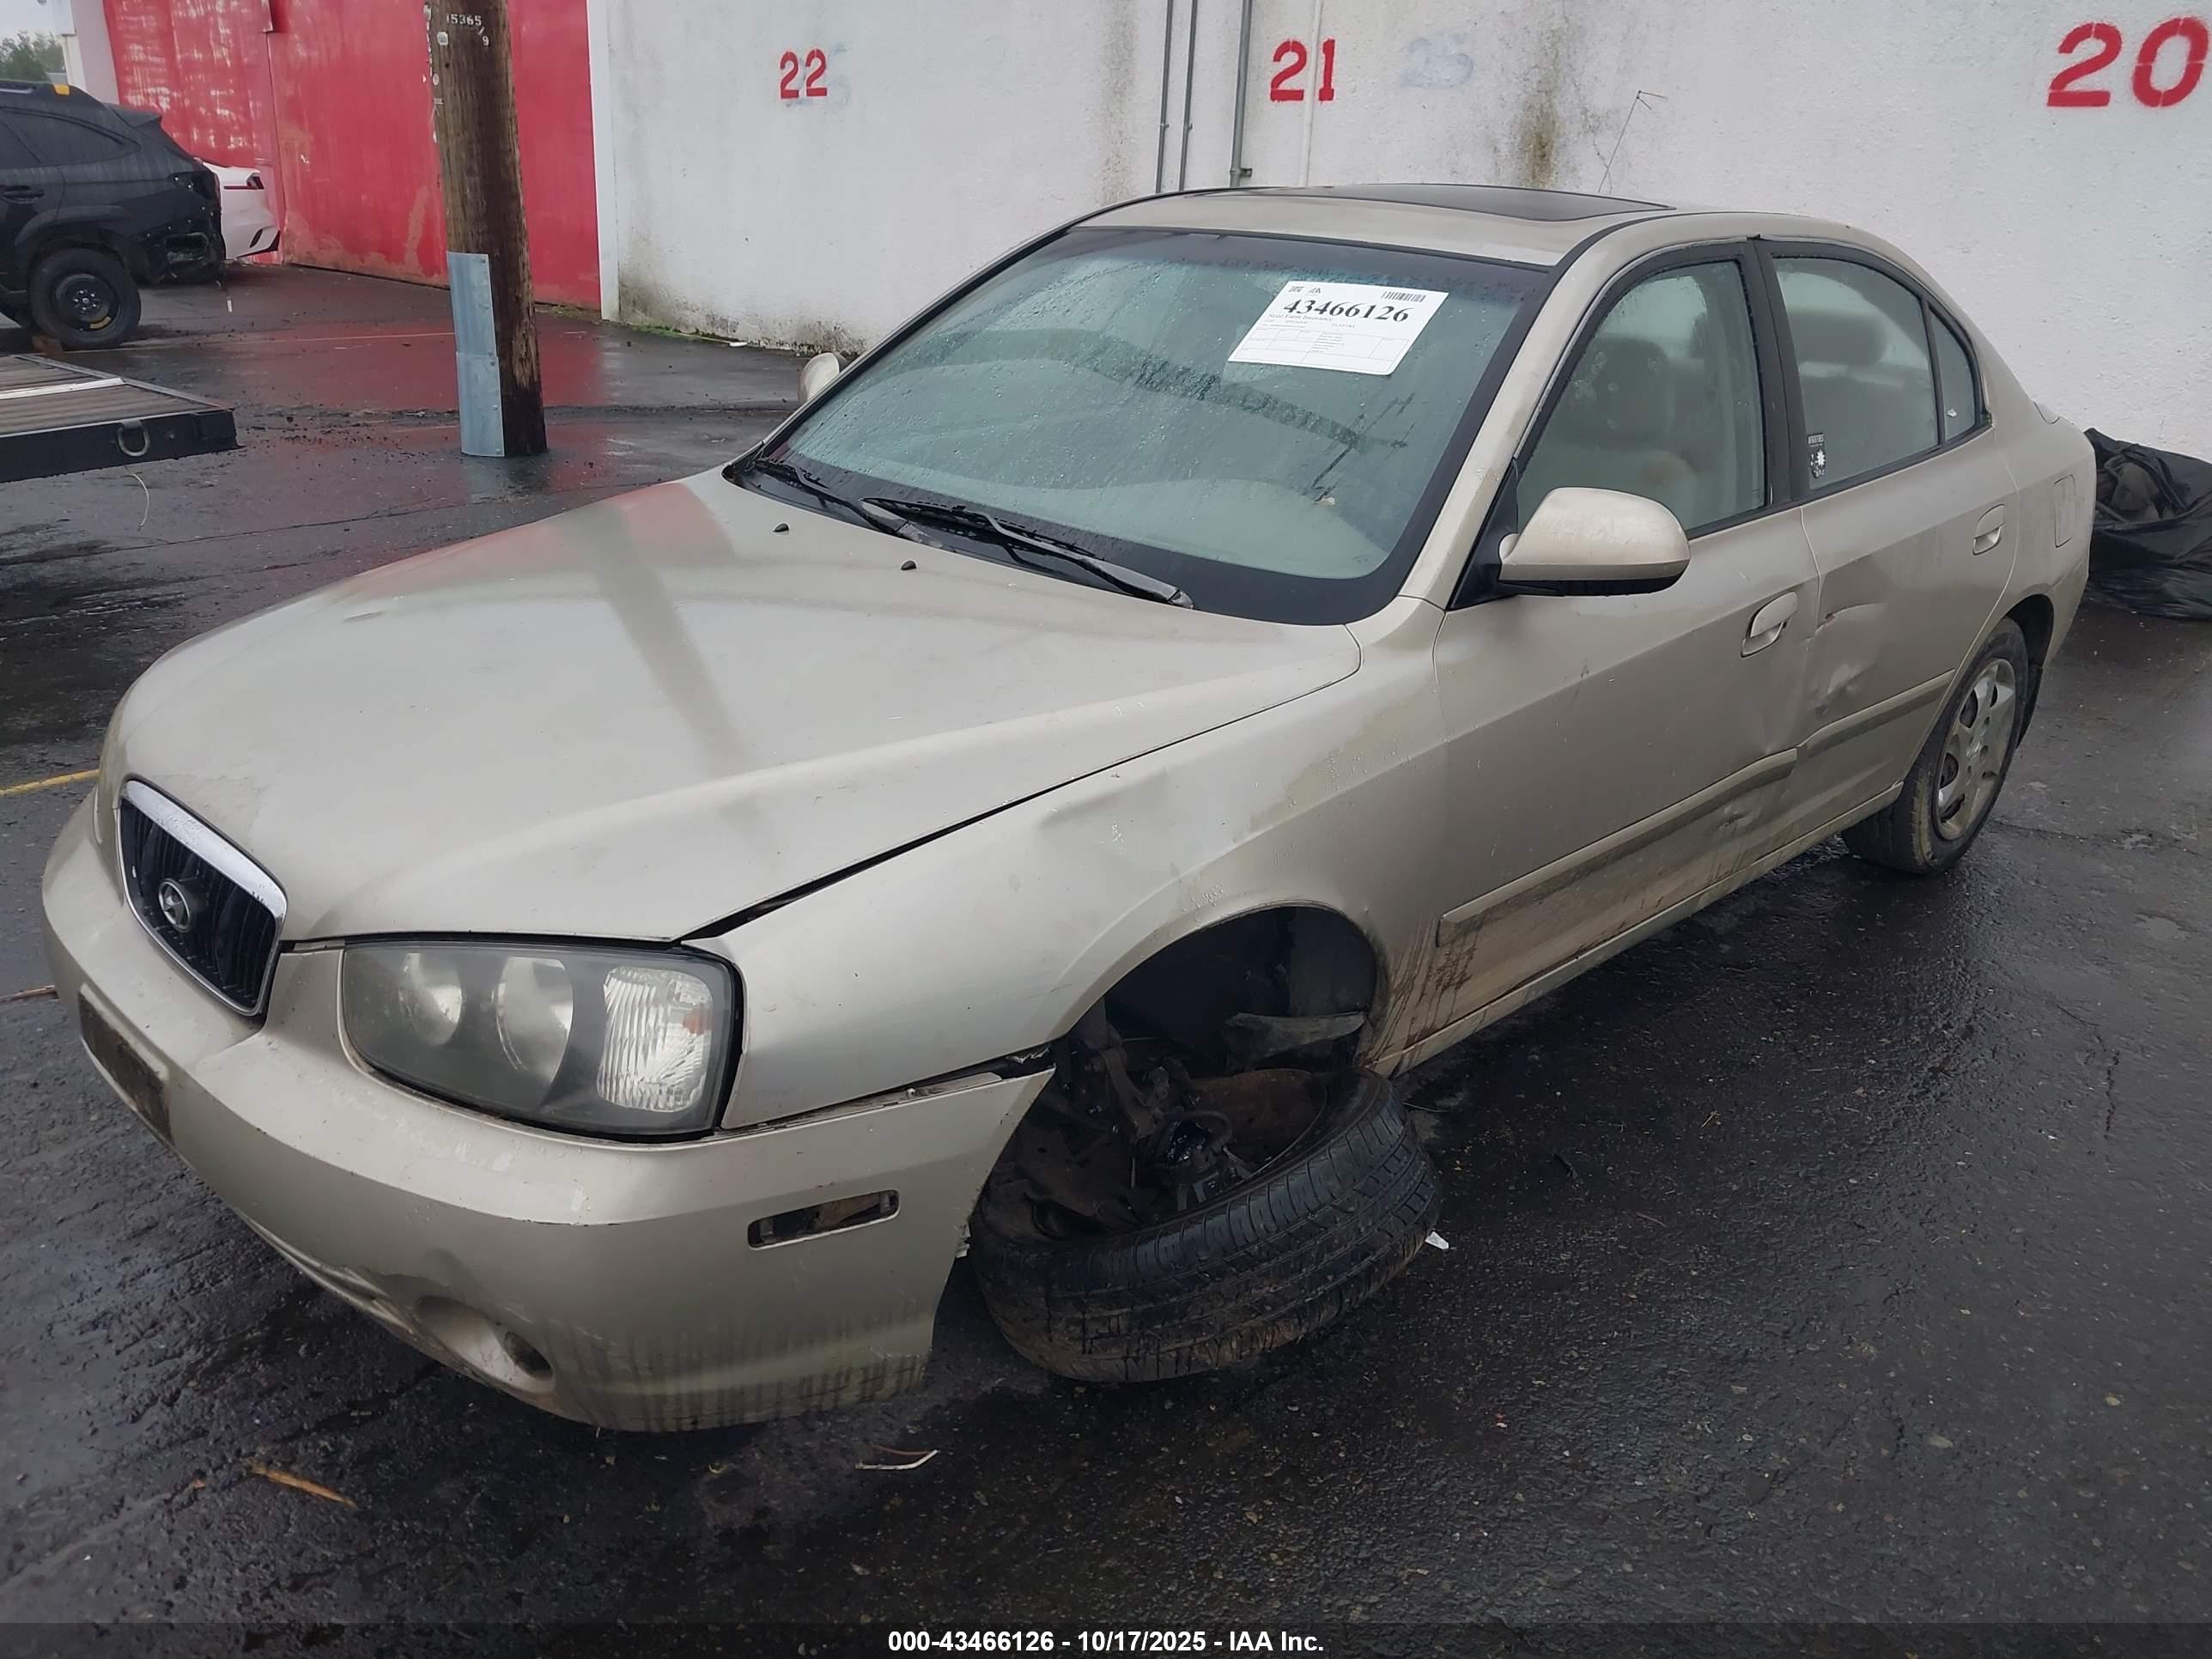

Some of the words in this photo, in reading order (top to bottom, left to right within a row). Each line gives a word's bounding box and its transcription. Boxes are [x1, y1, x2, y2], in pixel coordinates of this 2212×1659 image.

[779, 48, 828, 100] 22
[1269, 38, 1336, 102] 21
[2046, 16, 2210, 108] 20
[1283, 298, 1415, 323] 43466126
